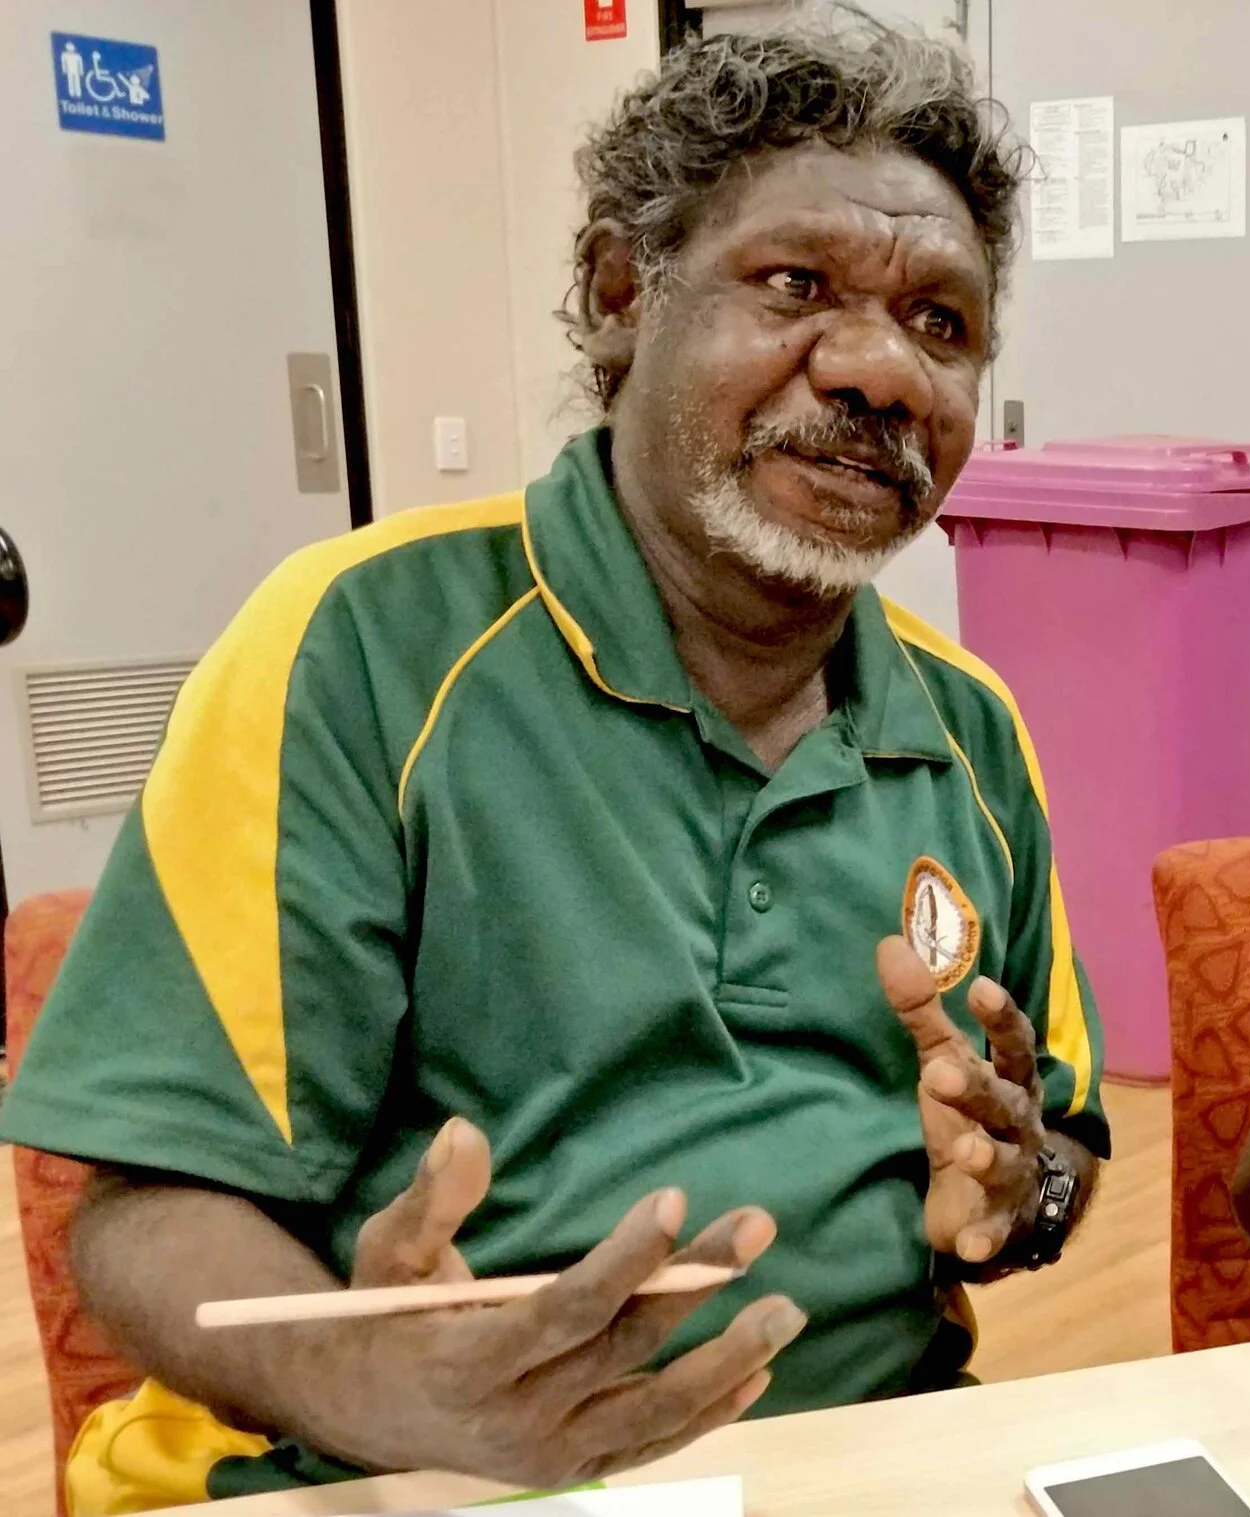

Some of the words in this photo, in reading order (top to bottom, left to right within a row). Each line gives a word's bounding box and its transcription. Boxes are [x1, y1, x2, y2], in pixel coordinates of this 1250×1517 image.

[62, 100, 99, 116] Toilet
[102, 105, 111, 118] &
[112, 106, 162, 124] Shower
